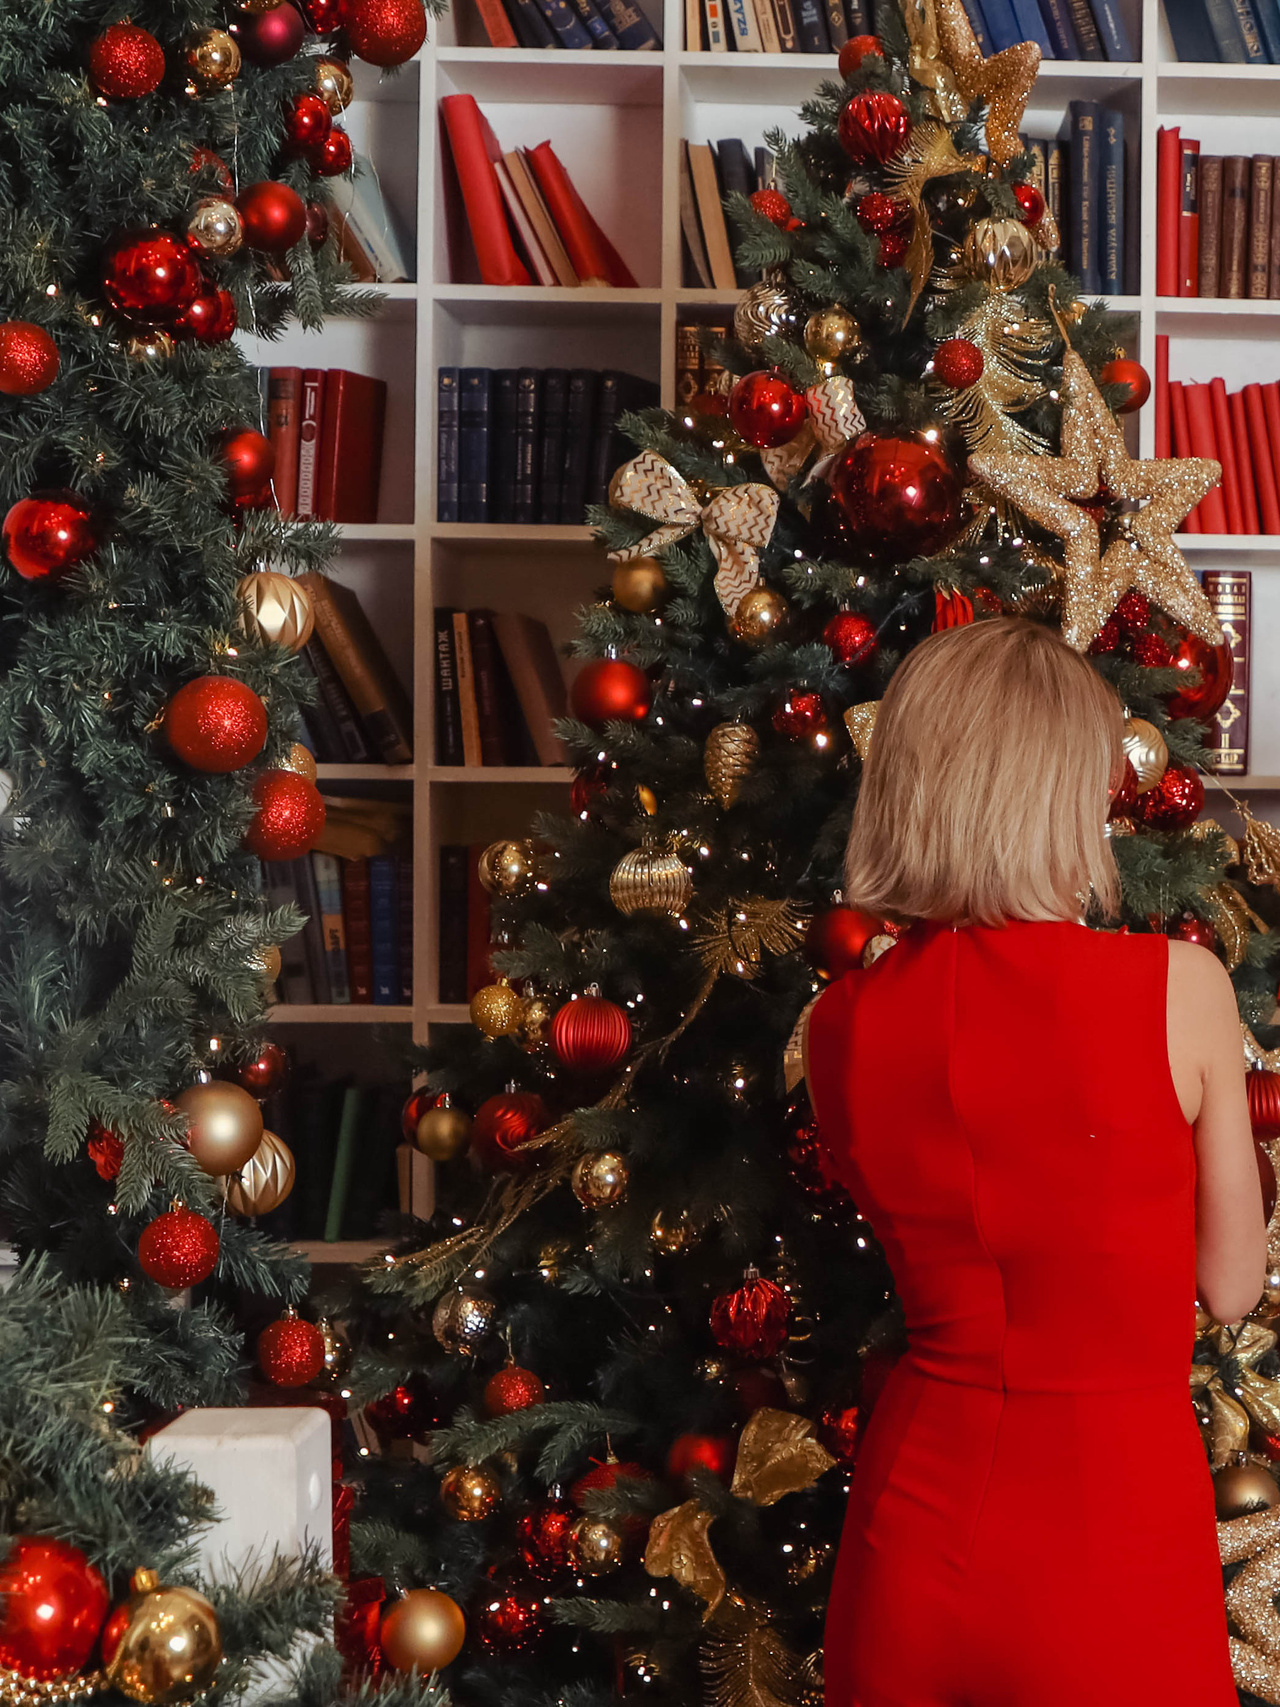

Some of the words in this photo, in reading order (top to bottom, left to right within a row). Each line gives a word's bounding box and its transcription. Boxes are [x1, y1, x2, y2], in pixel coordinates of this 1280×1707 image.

[1106, 164, 1116, 224] ВИЗАНТИИ
[1107, 228, 1117, 279] КУЛЬТУРА
[437, 629, 452, 691] ШАНТАЖ
